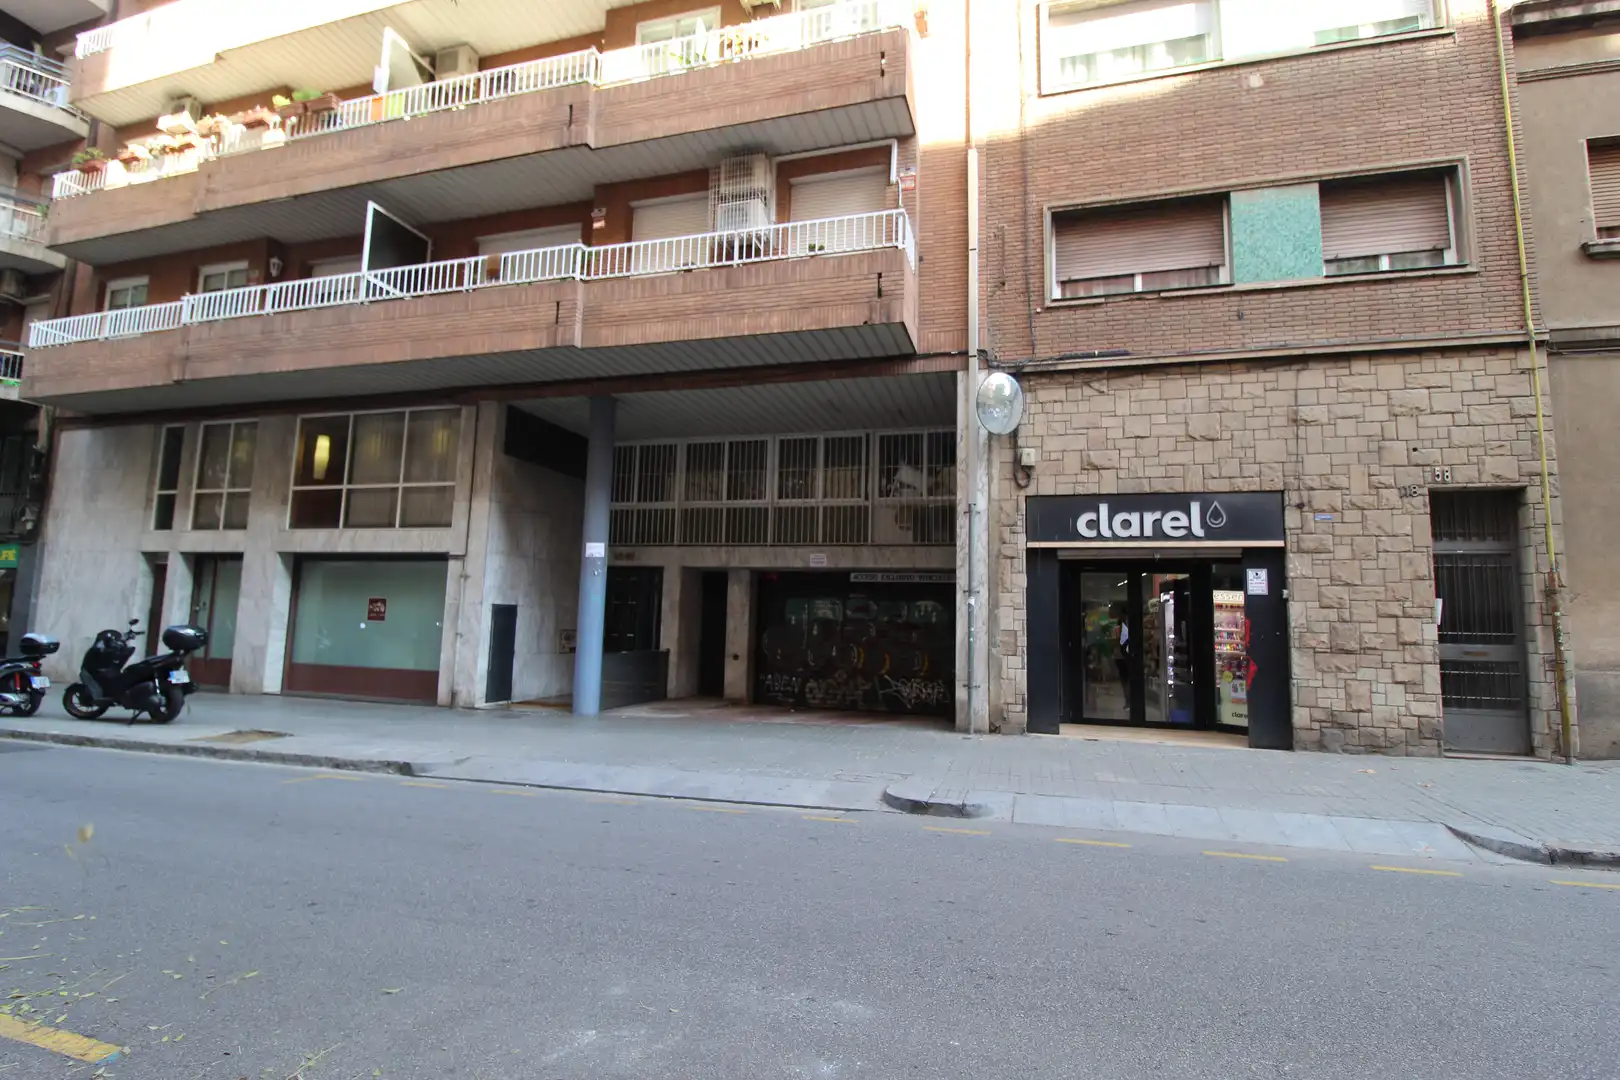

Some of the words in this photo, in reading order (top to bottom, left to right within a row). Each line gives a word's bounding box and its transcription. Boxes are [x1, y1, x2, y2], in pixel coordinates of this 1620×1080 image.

[1434, 466, 1451, 482] 58
[1399, 484, 1419, 498] 118
[1076, 501, 1205, 538] clarel
